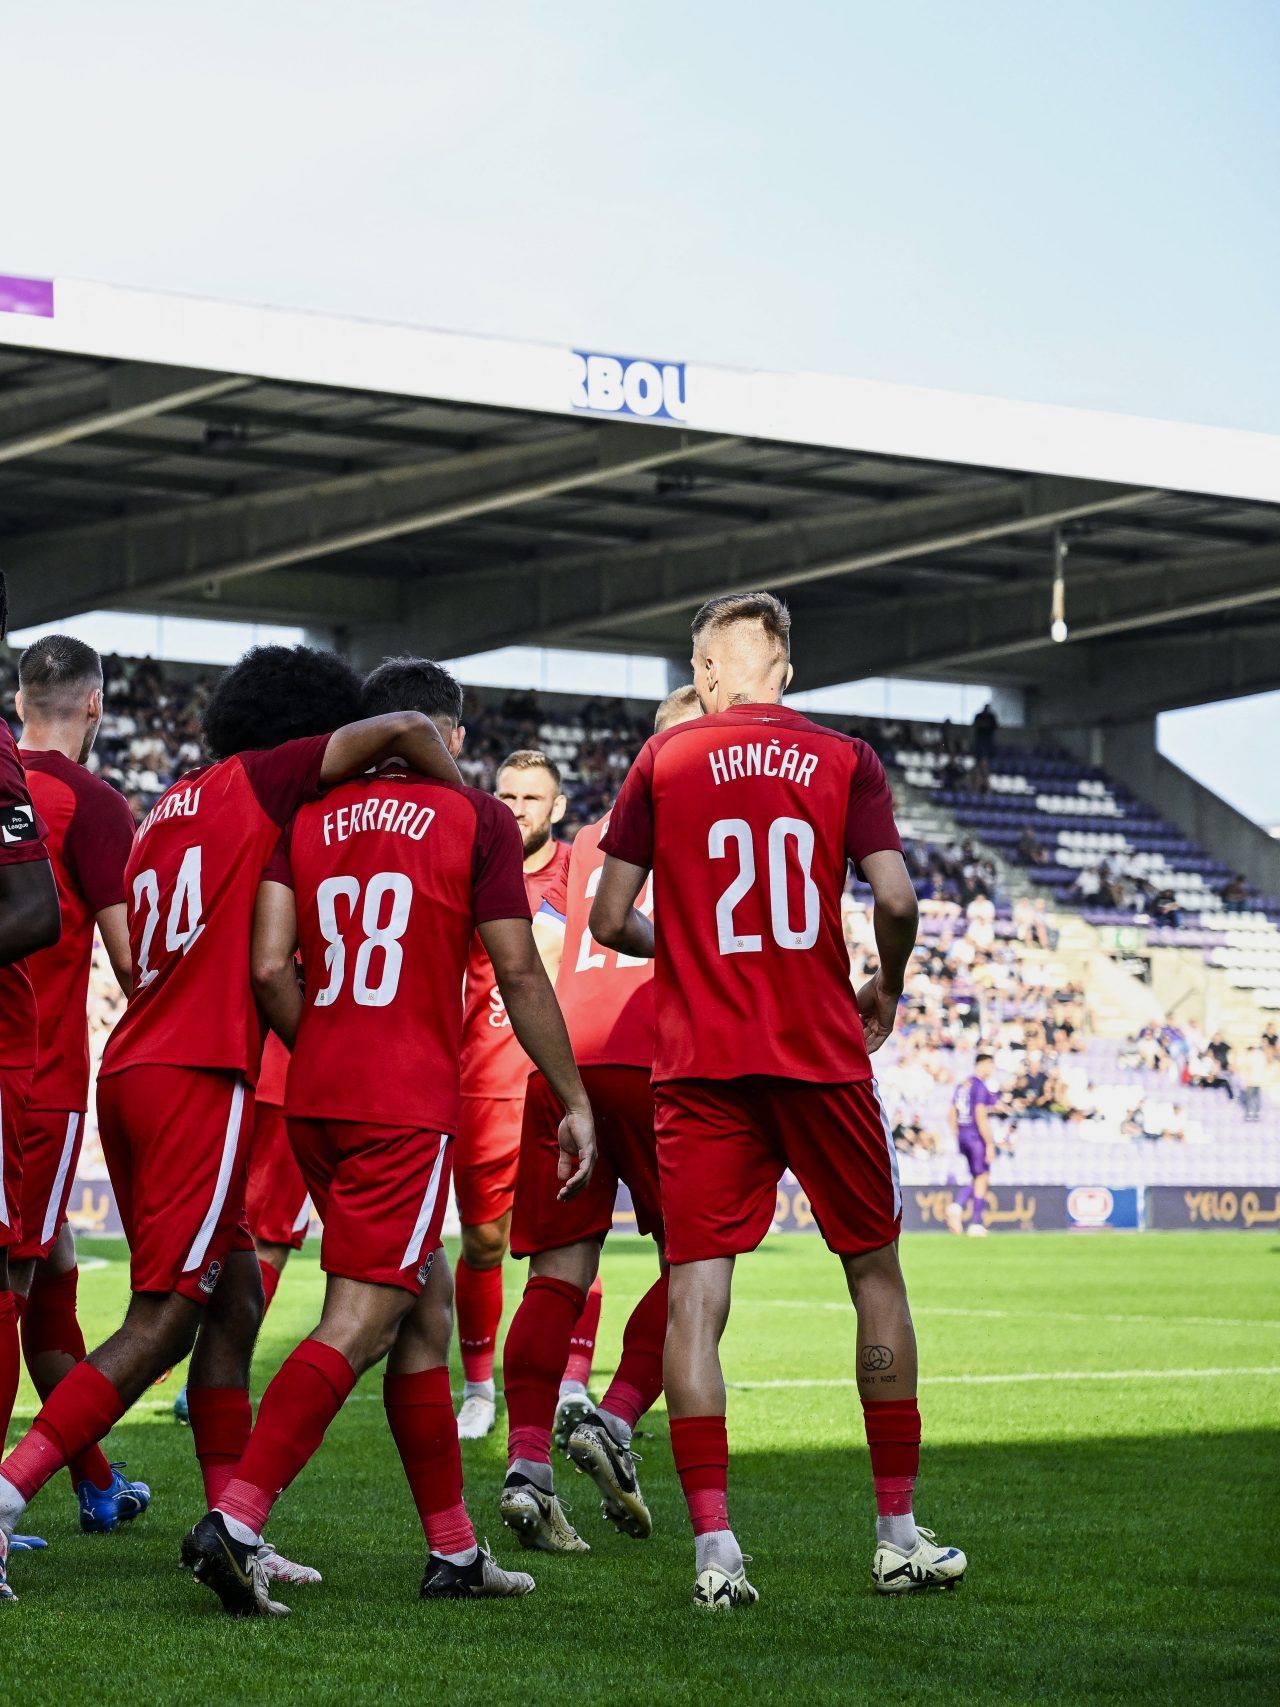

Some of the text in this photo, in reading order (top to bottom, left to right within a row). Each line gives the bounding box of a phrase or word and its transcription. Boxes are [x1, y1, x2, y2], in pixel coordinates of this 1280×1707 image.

[708, 738, 819, 787] HRNČÁR
[7, 822, 29, 830] League
[323, 798, 436, 846] FERRARO
[707, 816, 820, 955] 20
[132, 845, 206, 989] 24
